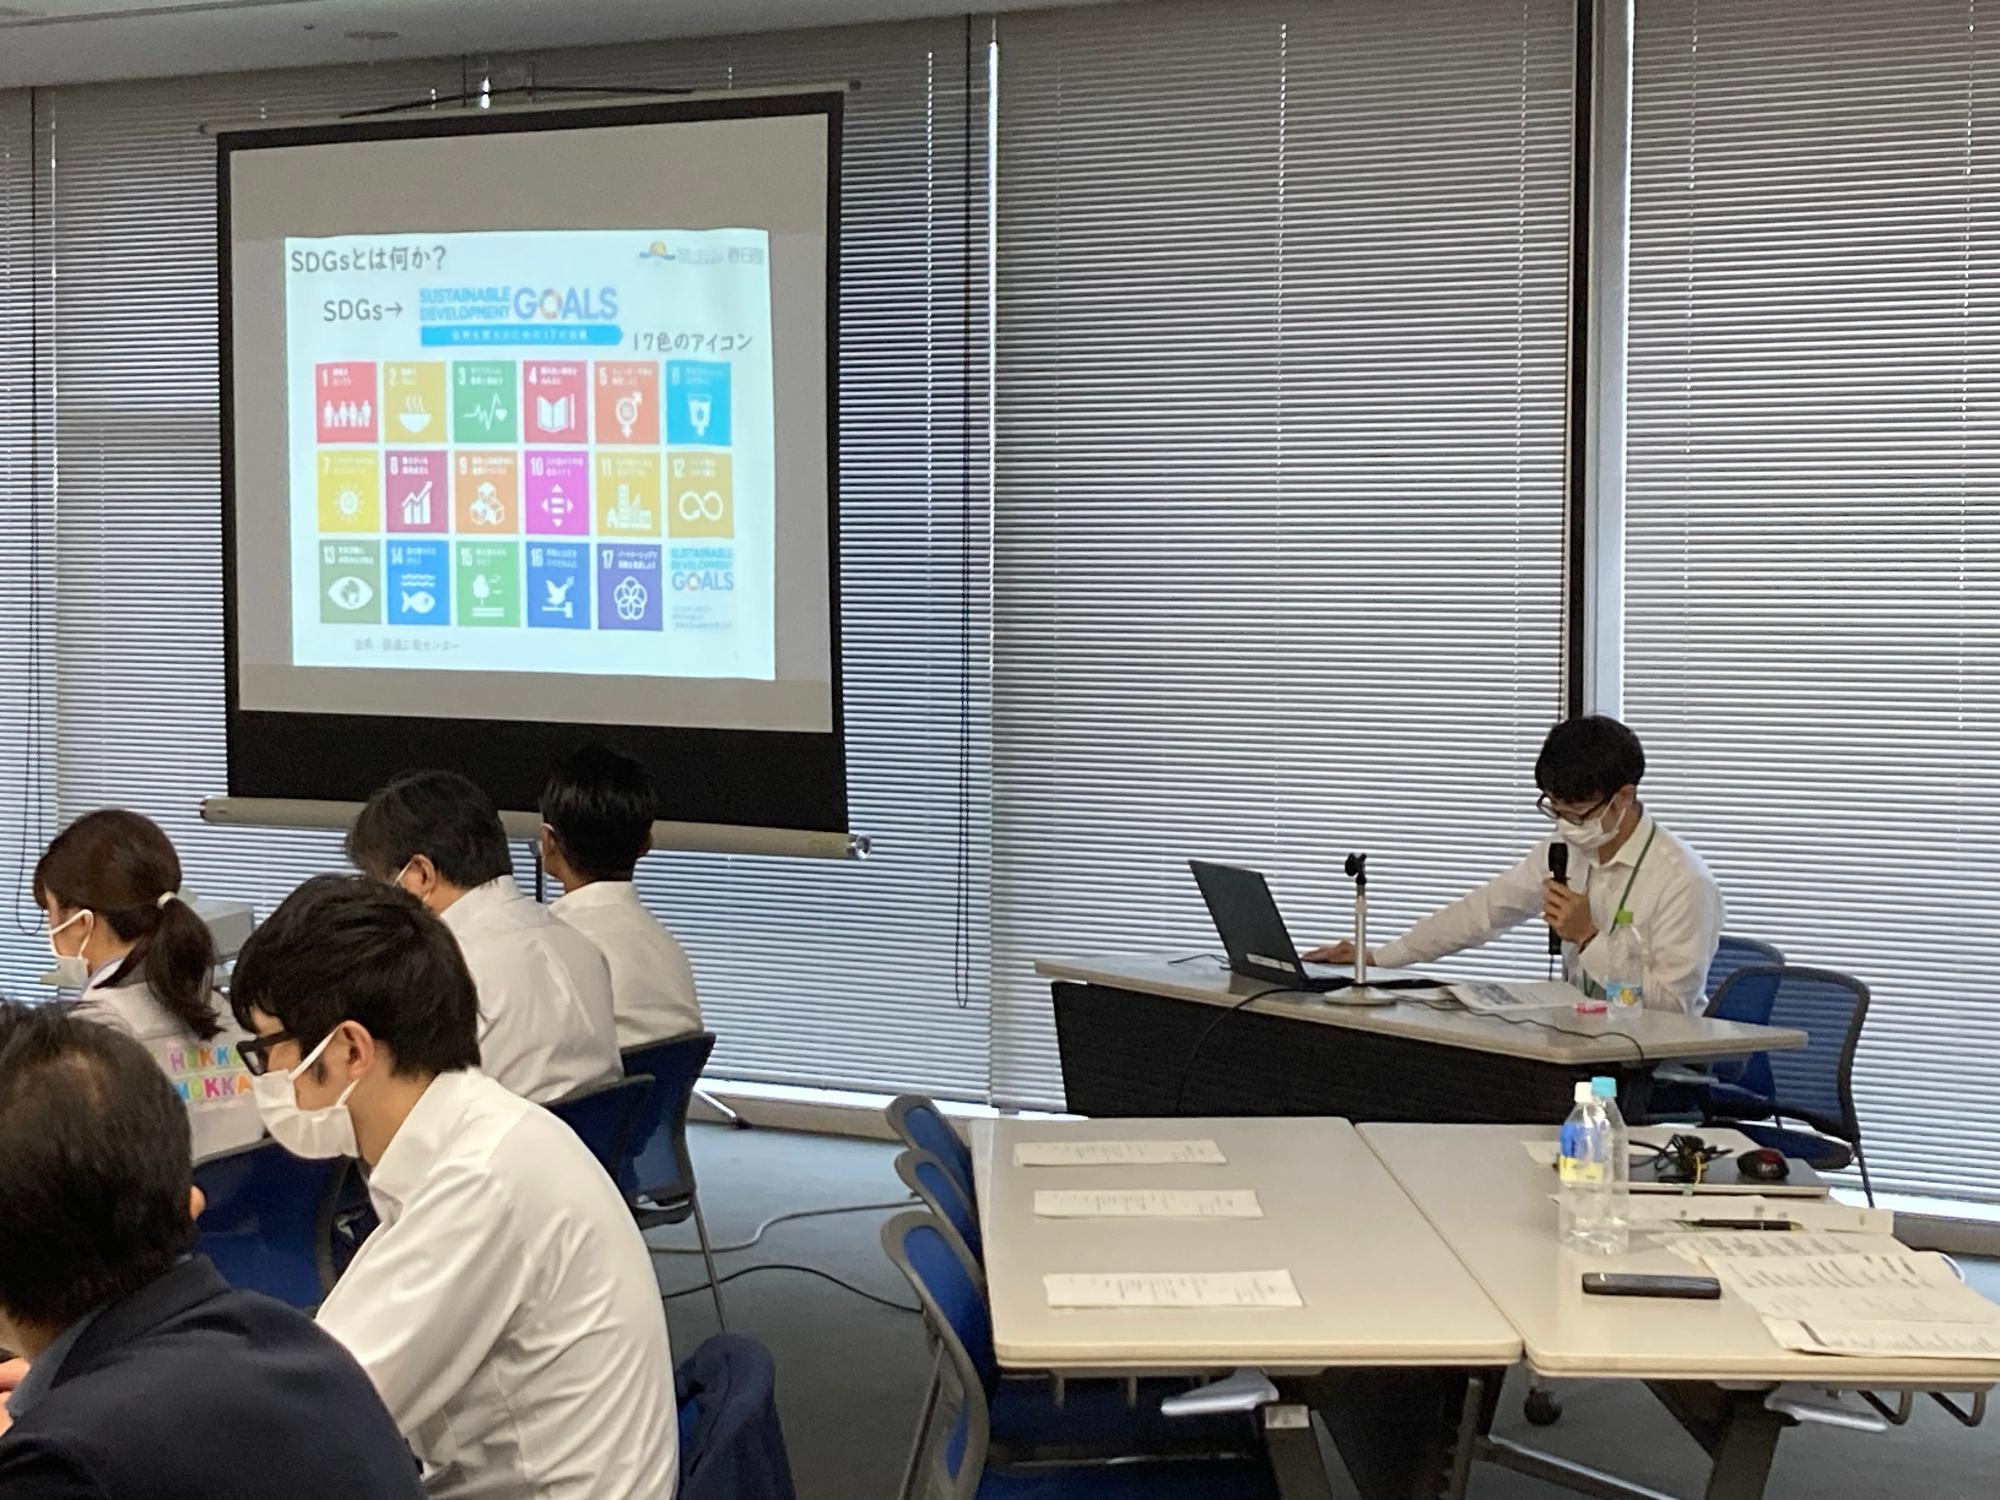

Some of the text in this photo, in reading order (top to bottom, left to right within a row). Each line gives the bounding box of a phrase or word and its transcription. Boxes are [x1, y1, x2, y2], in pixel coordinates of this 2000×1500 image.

[291, 245, 447, 273] SDGsとは何か？
[419, 286, 511, 304] SUSTAINABLE
[513, 286, 618, 320] GOALS
[322, 297, 383, 322] SDGs
[419, 305, 511, 321] DEVELOPMENT
[632, 331, 753, 353] 17色のアイコン
[322, 369, 328, 388] 1
[388, 367, 397, 387] 2
[528, 366, 538, 385] 4
[599, 366, 608, 386] 5
[530, 456, 544, 477] 10
[601, 457, 613, 477] 11
[673, 458, 686, 478] 12
[391, 545, 403, 565] 14
[602, 549, 614, 569] 17
[671, 570, 734, 592] GOALS
